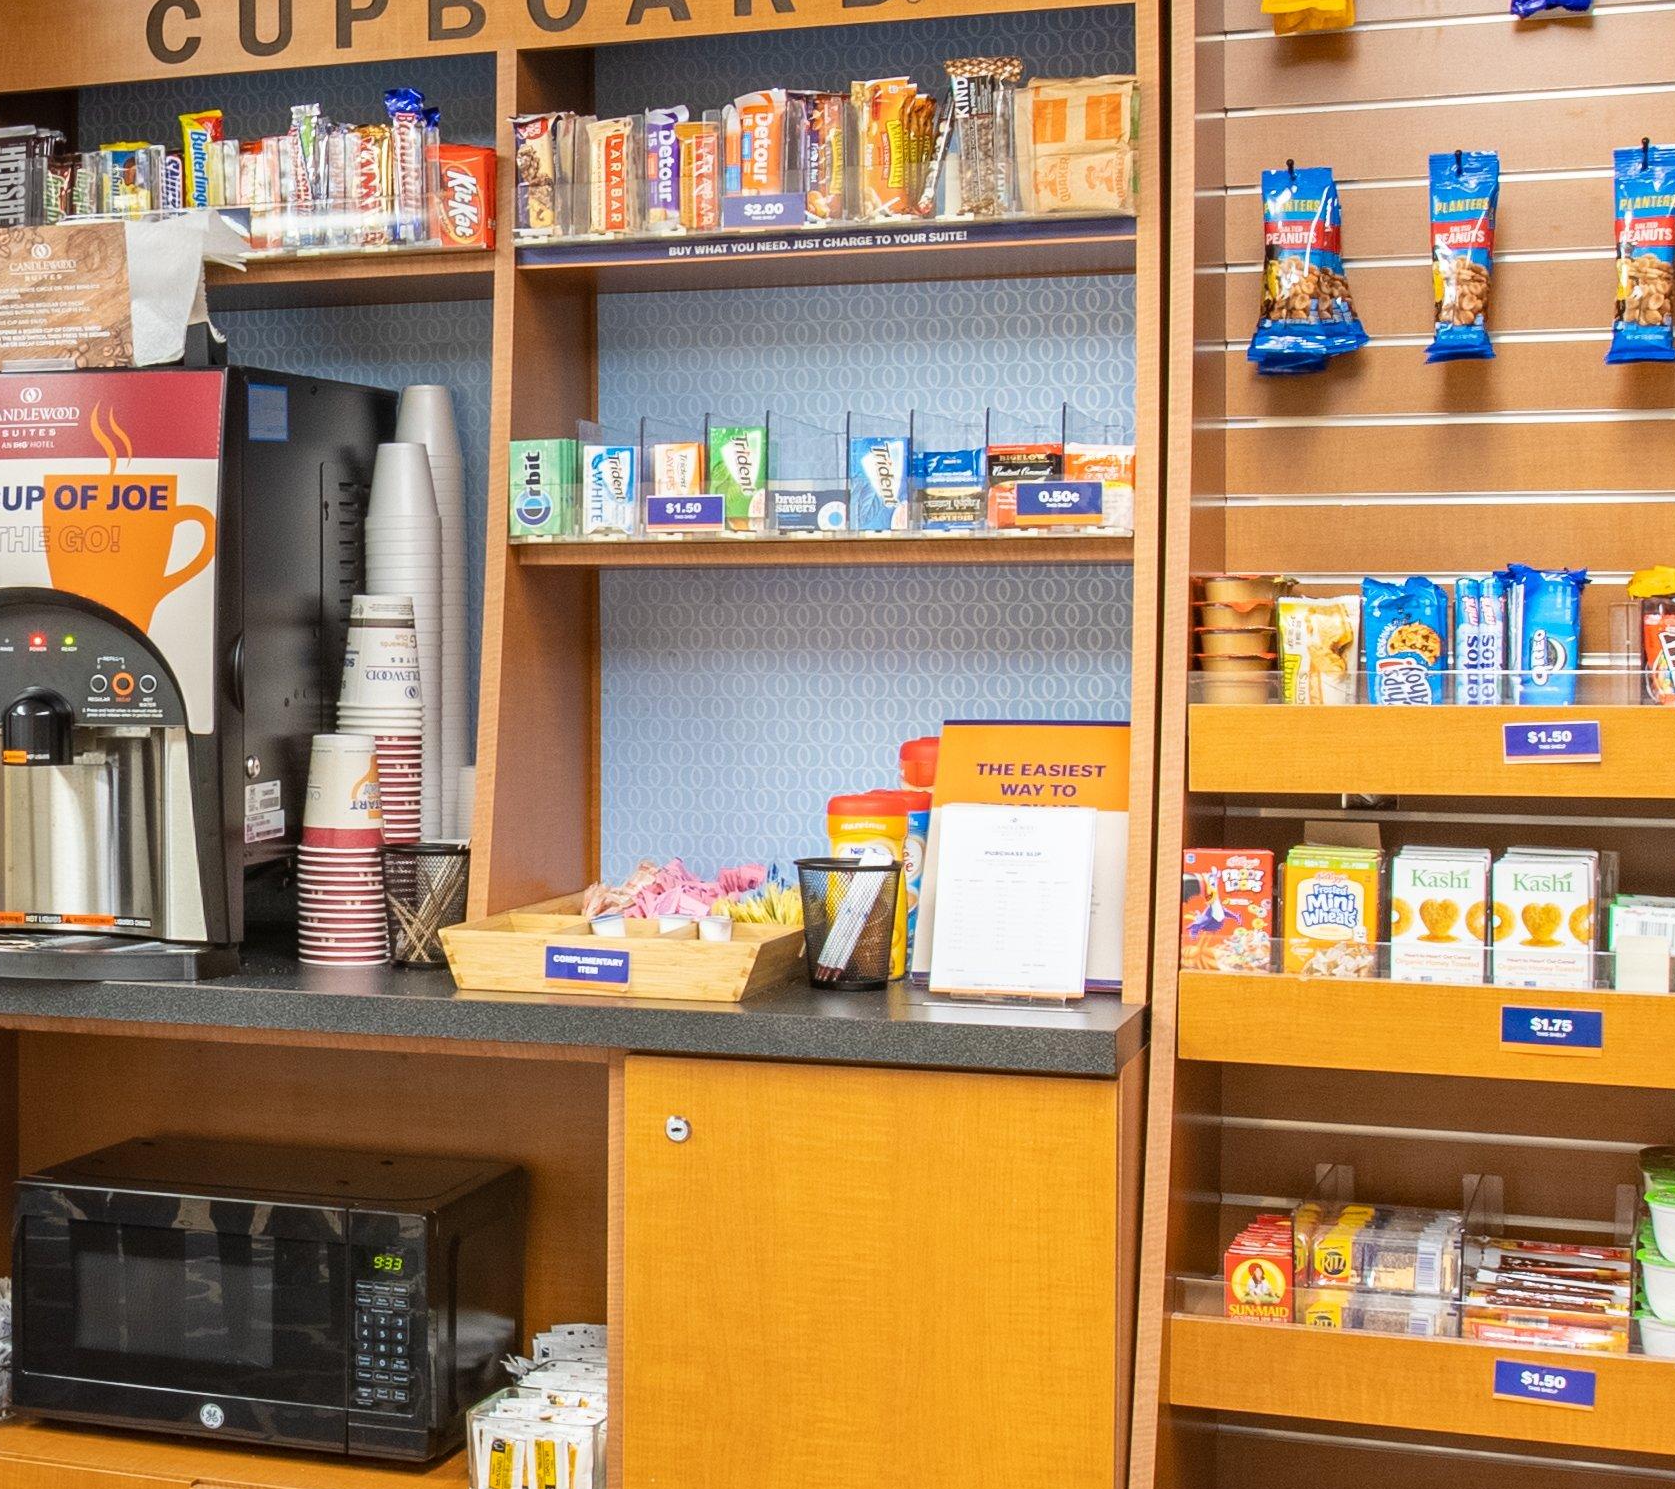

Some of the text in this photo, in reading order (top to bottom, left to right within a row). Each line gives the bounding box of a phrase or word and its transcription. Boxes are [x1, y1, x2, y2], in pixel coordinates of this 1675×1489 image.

[955, 76, 970, 119] KIND
[753, 112, 774, 183] Detour
[658, 130, 676, 203] Detour
[744, 203, 784, 216] $2.00
[668, 230, 967, 256] BUY WHAT YOU NEED. JUST CHARGE TO YOUR SUITE!
[9, 260, 76, 272] CANDLEWOOD
[2, 427, 57, 438] SUITES
[665, 448, 674, 492] LAYERS
[731, 432, 756, 495] Trident
[607, 451, 627, 502] Trident
[870, 442, 899, 507] Trident
[53, 484, 97, 511] OF
[106, 484, 169, 511] JOE
[591, 470, 604, 524] WHITE
[775, 493, 817, 505] breath
[1038, 491, 1080, 504] 0.50¢
[665, 502, 702, 515] $1.50
[775, 502, 817, 513] savers
[58, 525, 120, 553] GO!
[1527, 730, 1572, 744] $1.50
[976, 763, 1106, 778] THE EASIEST
[1001, 783, 1077, 797] WAY TO
[1411, 869, 1470, 891] Kashi
[1513, 872, 1572, 893] Kashi
[1307, 893, 1355, 913] Mini
[1301, 909, 1356, 928] Wheats
[553, 955, 623, 967] COMPLIMENTARY
[578, 965, 598, 975] ITEM
[1529, 1016, 1573, 1034] $1.75
[1520, 1370, 1567, 1389] $1.50
